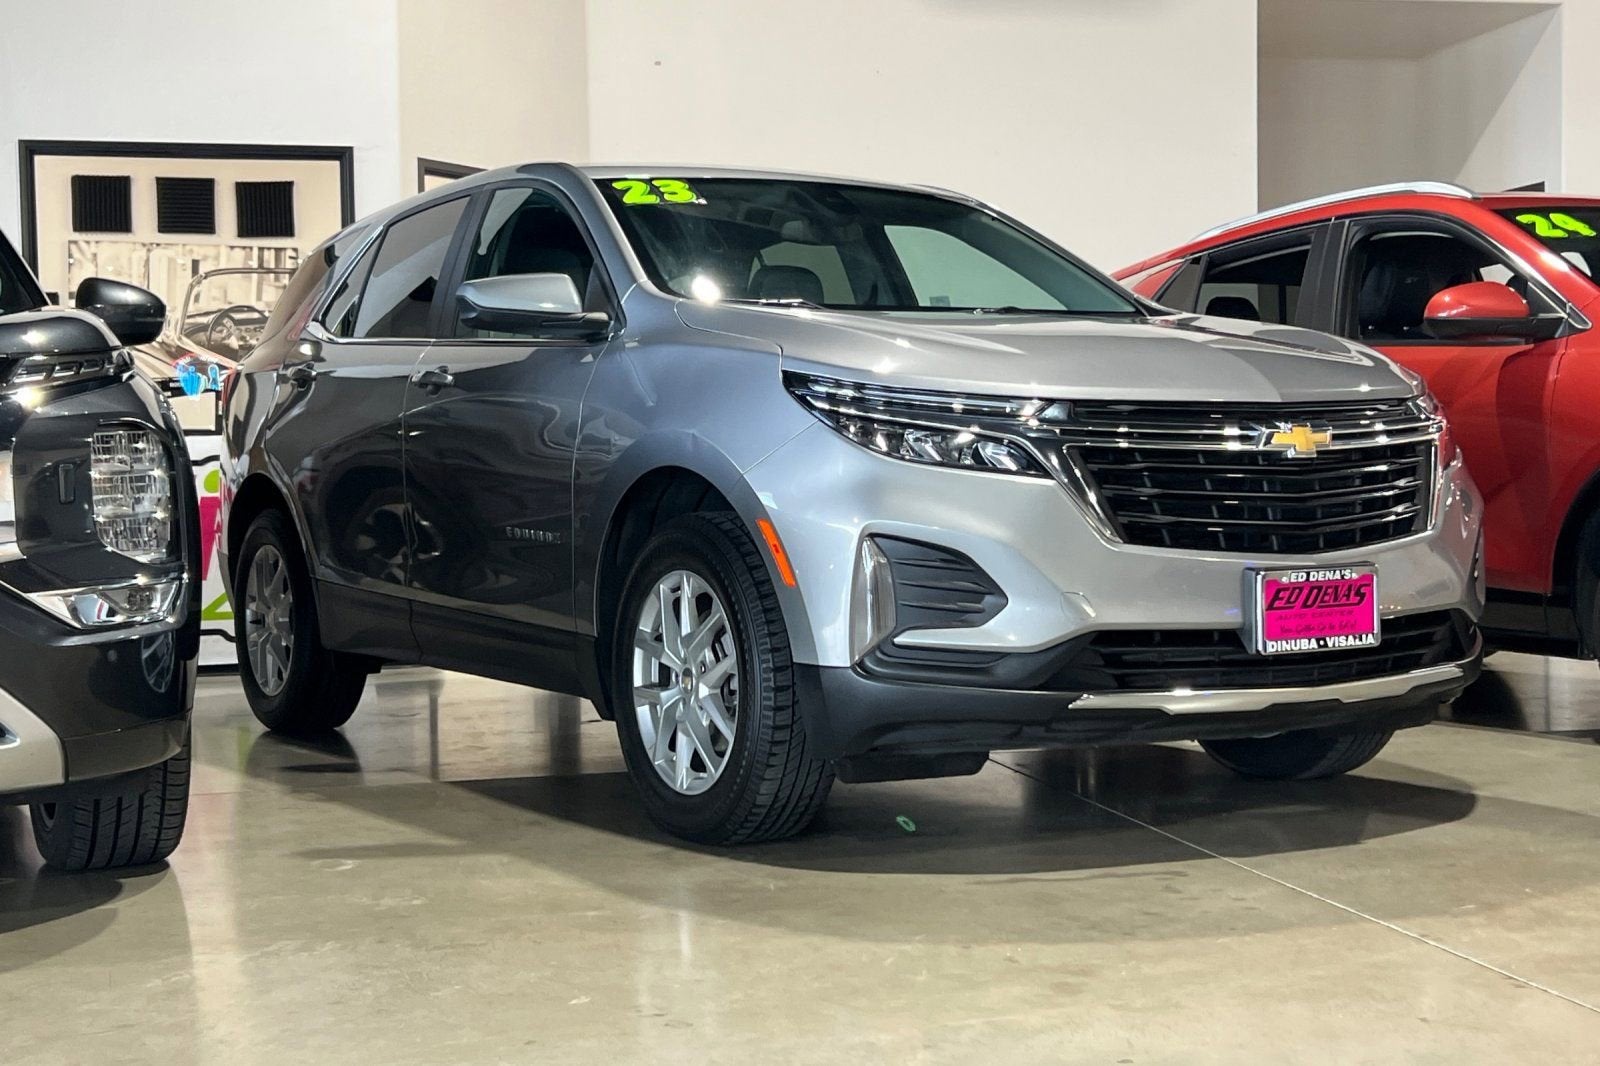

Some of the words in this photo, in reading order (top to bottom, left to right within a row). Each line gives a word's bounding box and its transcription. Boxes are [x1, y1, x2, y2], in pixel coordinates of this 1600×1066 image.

[611, 179, 697, 204] 23
[1515, 212, 1597, 238] 24
[1290, 571, 1307, 583] ED
[1309, 569, 1351, 581] DENA'S
[1265, 586, 1304, 611] ED
[1268, 638, 1318, 653] DINUBA
[1326, 633, 1375, 648] VISALIA
